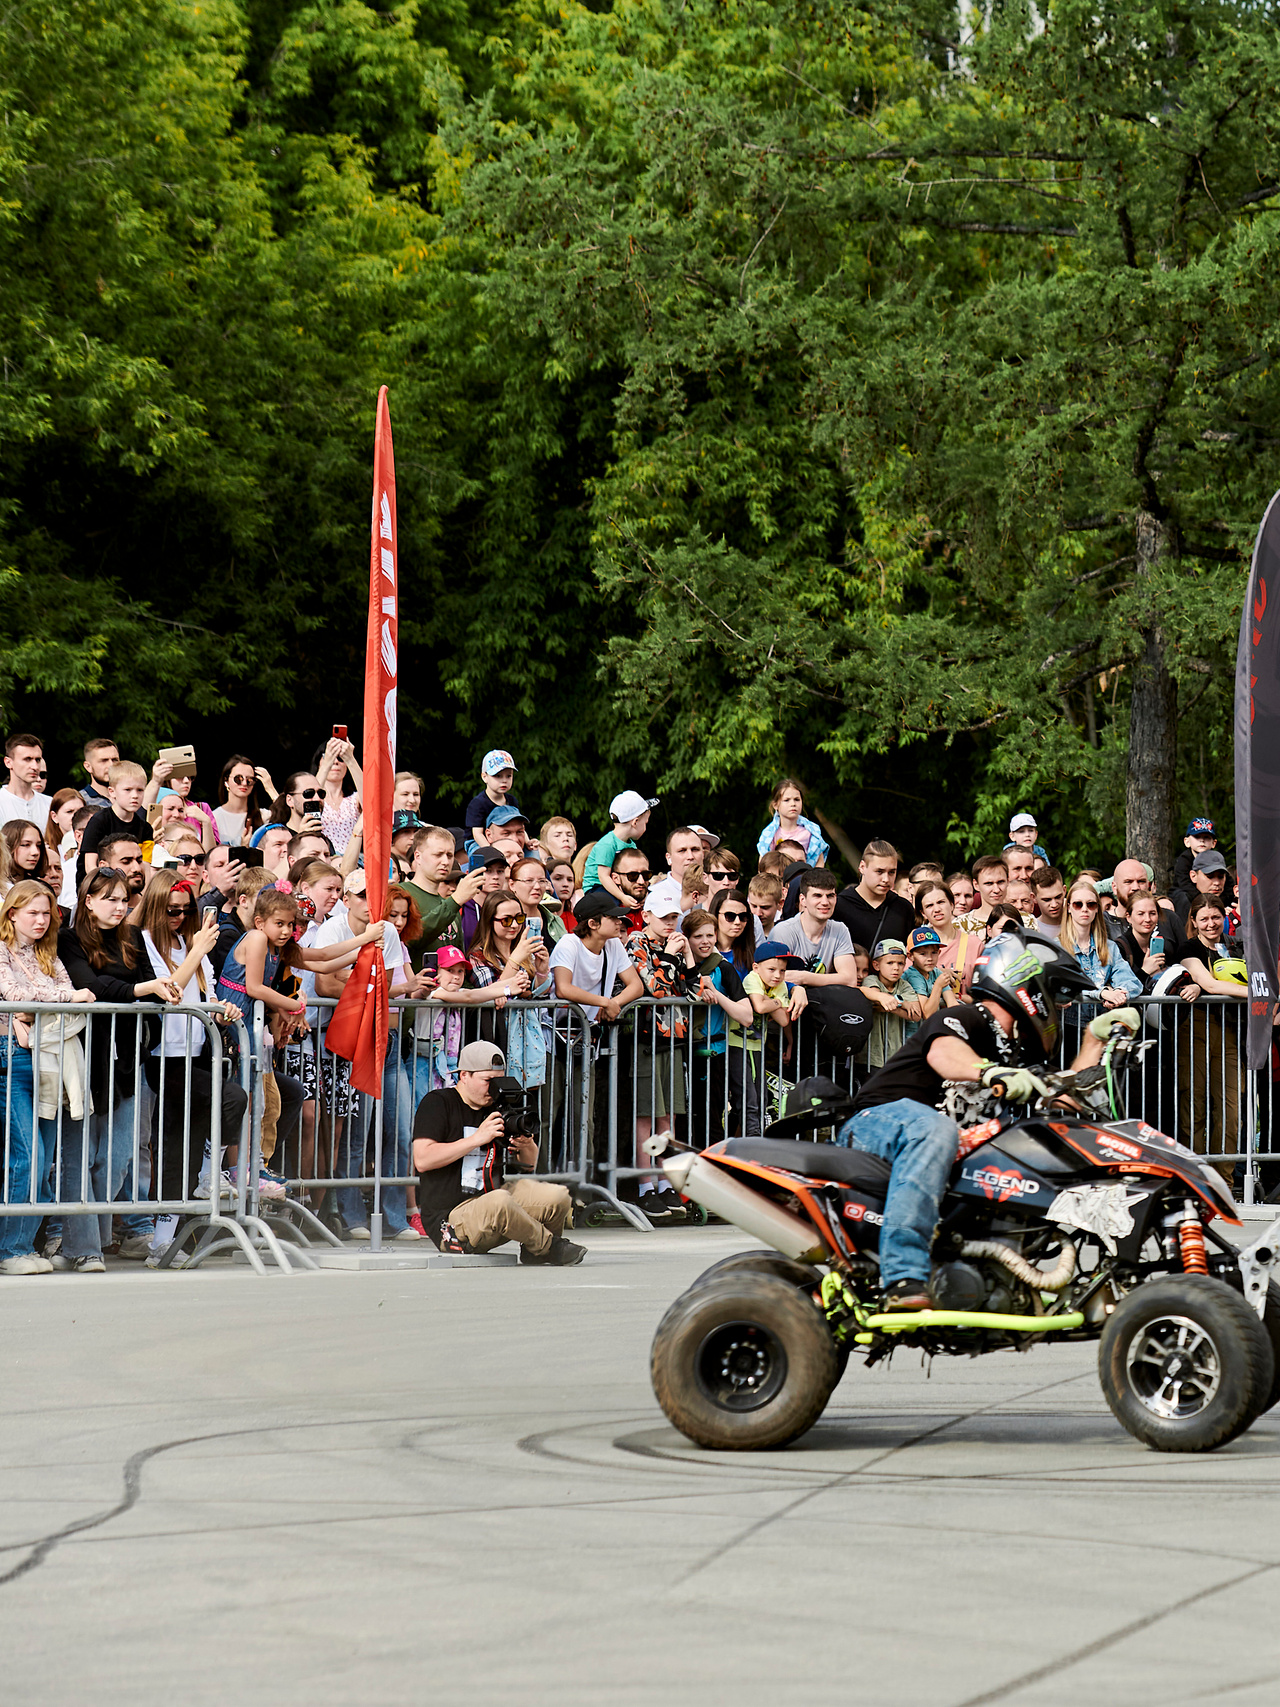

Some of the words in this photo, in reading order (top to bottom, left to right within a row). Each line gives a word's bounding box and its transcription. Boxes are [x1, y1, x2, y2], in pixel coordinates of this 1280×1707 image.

[1016, 989, 1036, 1015] MOTUL
[1096, 1135, 1140, 1158] MOTUL
[961, 1167, 1040, 1194] LEGEND
